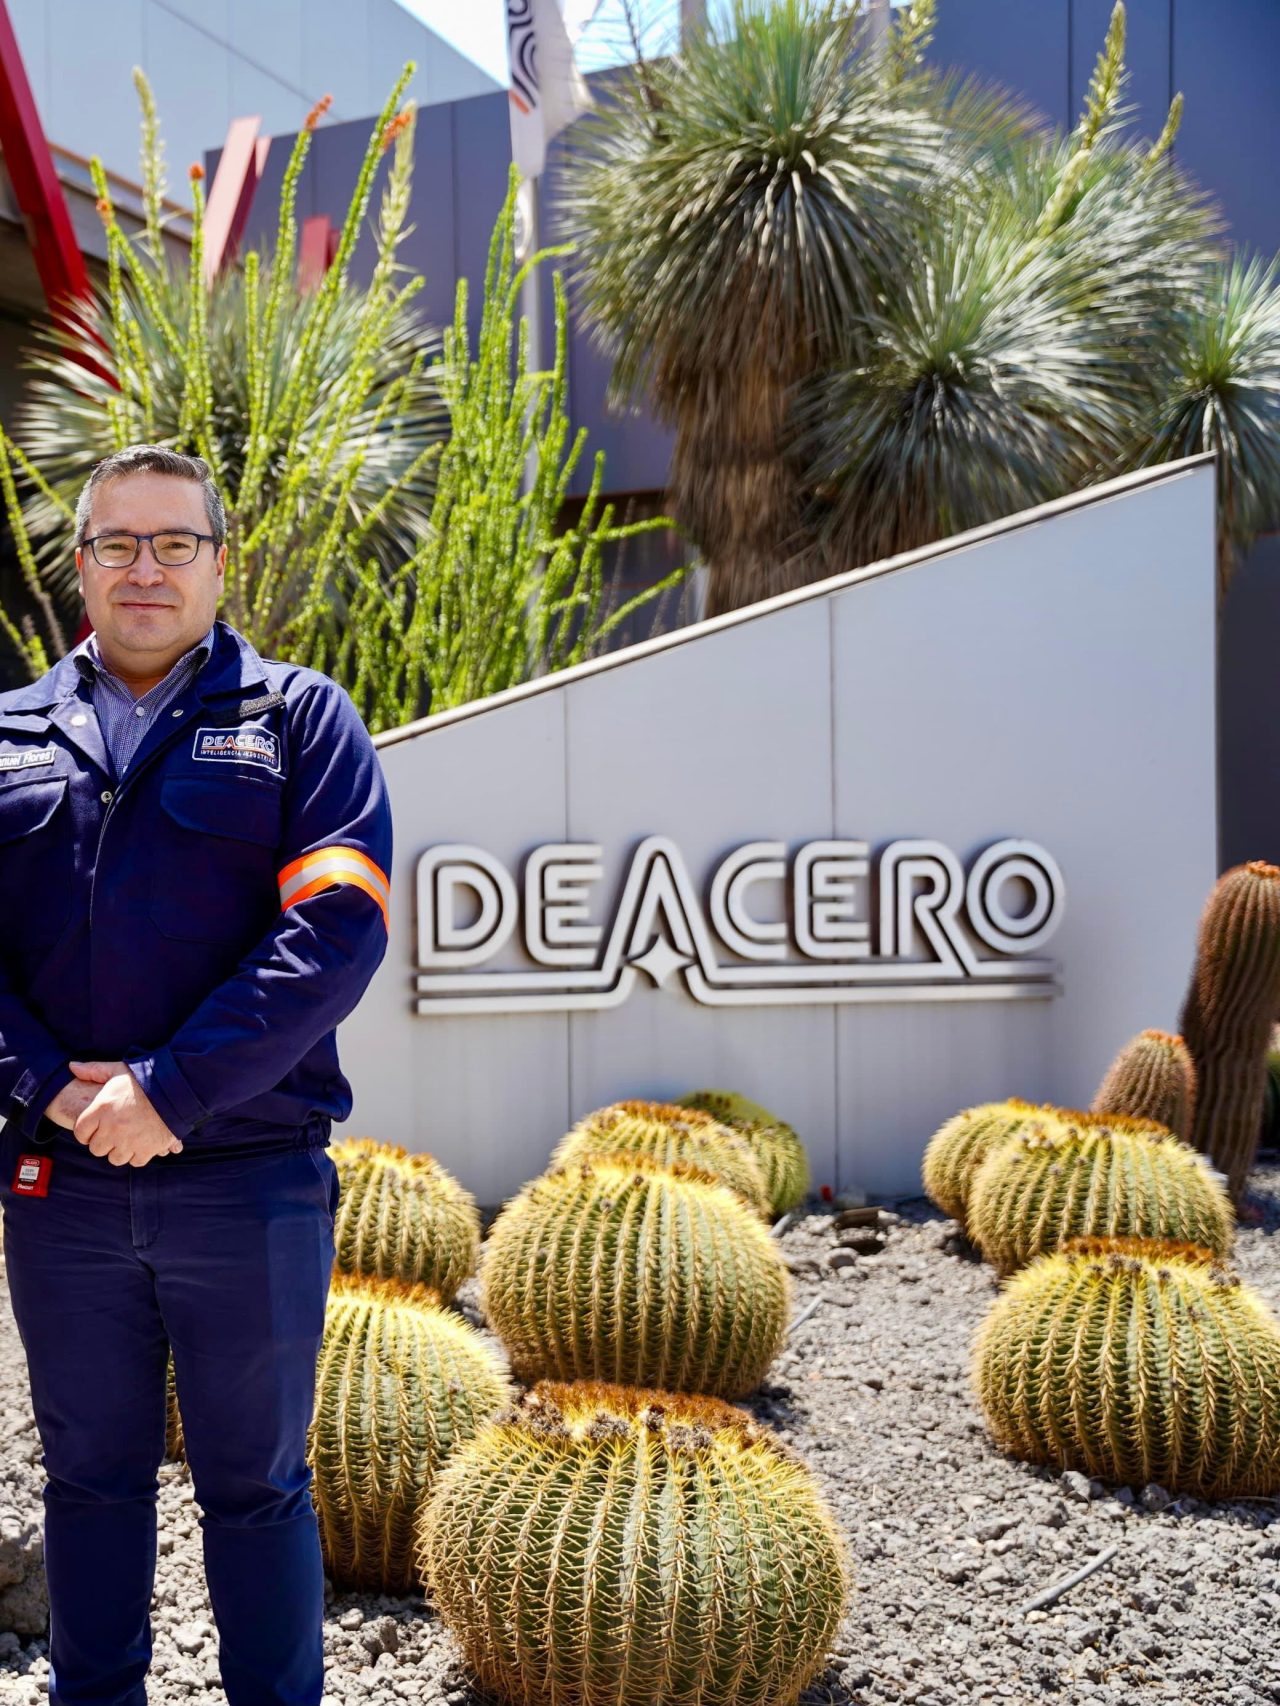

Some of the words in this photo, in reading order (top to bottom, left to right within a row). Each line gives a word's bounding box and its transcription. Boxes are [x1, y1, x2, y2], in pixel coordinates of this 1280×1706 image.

[202, 735, 275, 753] DEACERO
[23, 751, 50, 763] Flores
[416, 836, 1066, 984] DEACERO
